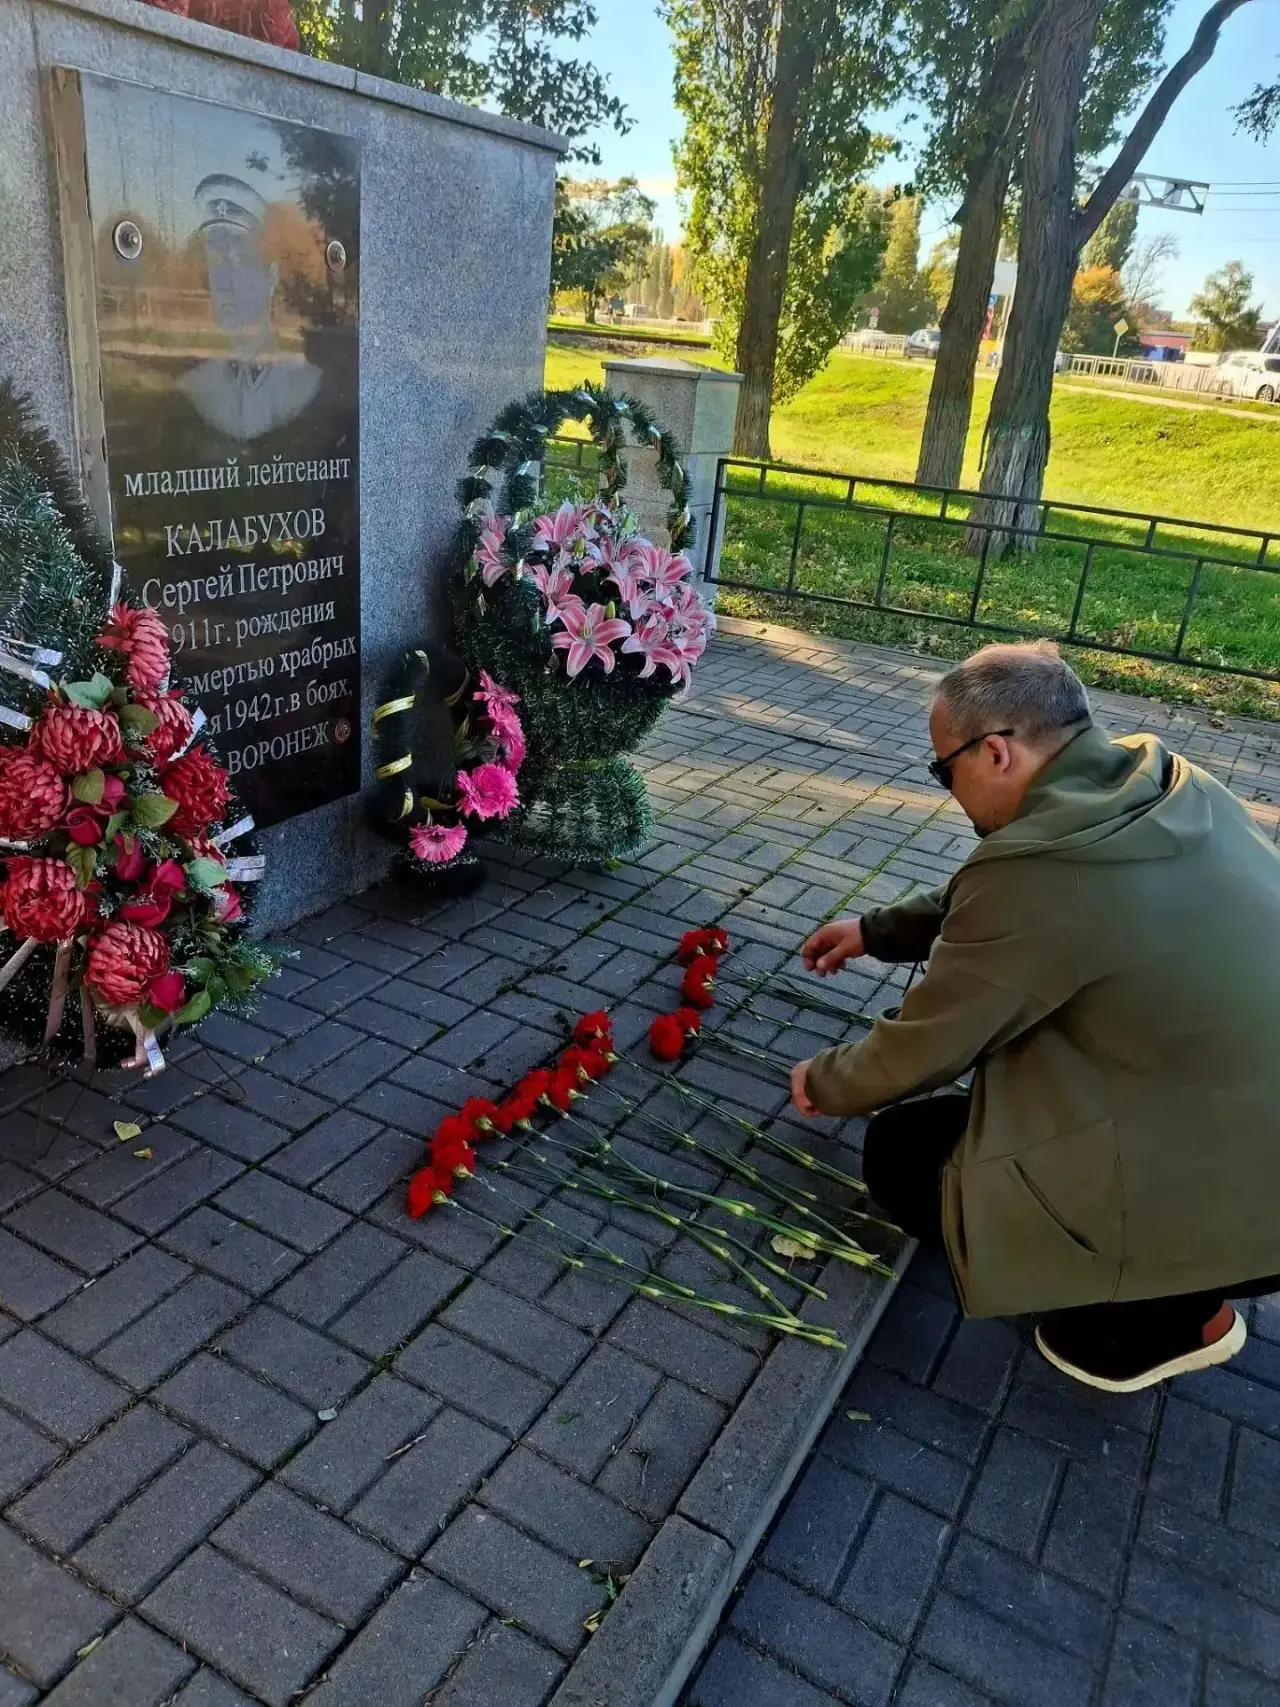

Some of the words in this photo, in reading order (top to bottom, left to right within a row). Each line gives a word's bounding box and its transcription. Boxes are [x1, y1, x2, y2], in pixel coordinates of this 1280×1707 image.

[124, 457, 240, 497] младший
[247, 454, 351, 487] лейтенант
[164, 508, 326, 557] КАЛАБУХОВ
[142, 565, 234, 615] Сергей
[238, 554, 345, 596] Петрович
[171, 618, 231, 655] 911г.
[235, 600, 335, 648] рождения
[279, 635, 358, 679] храбрых
[226, 720, 330, 776] ВОРОНЕЖ
